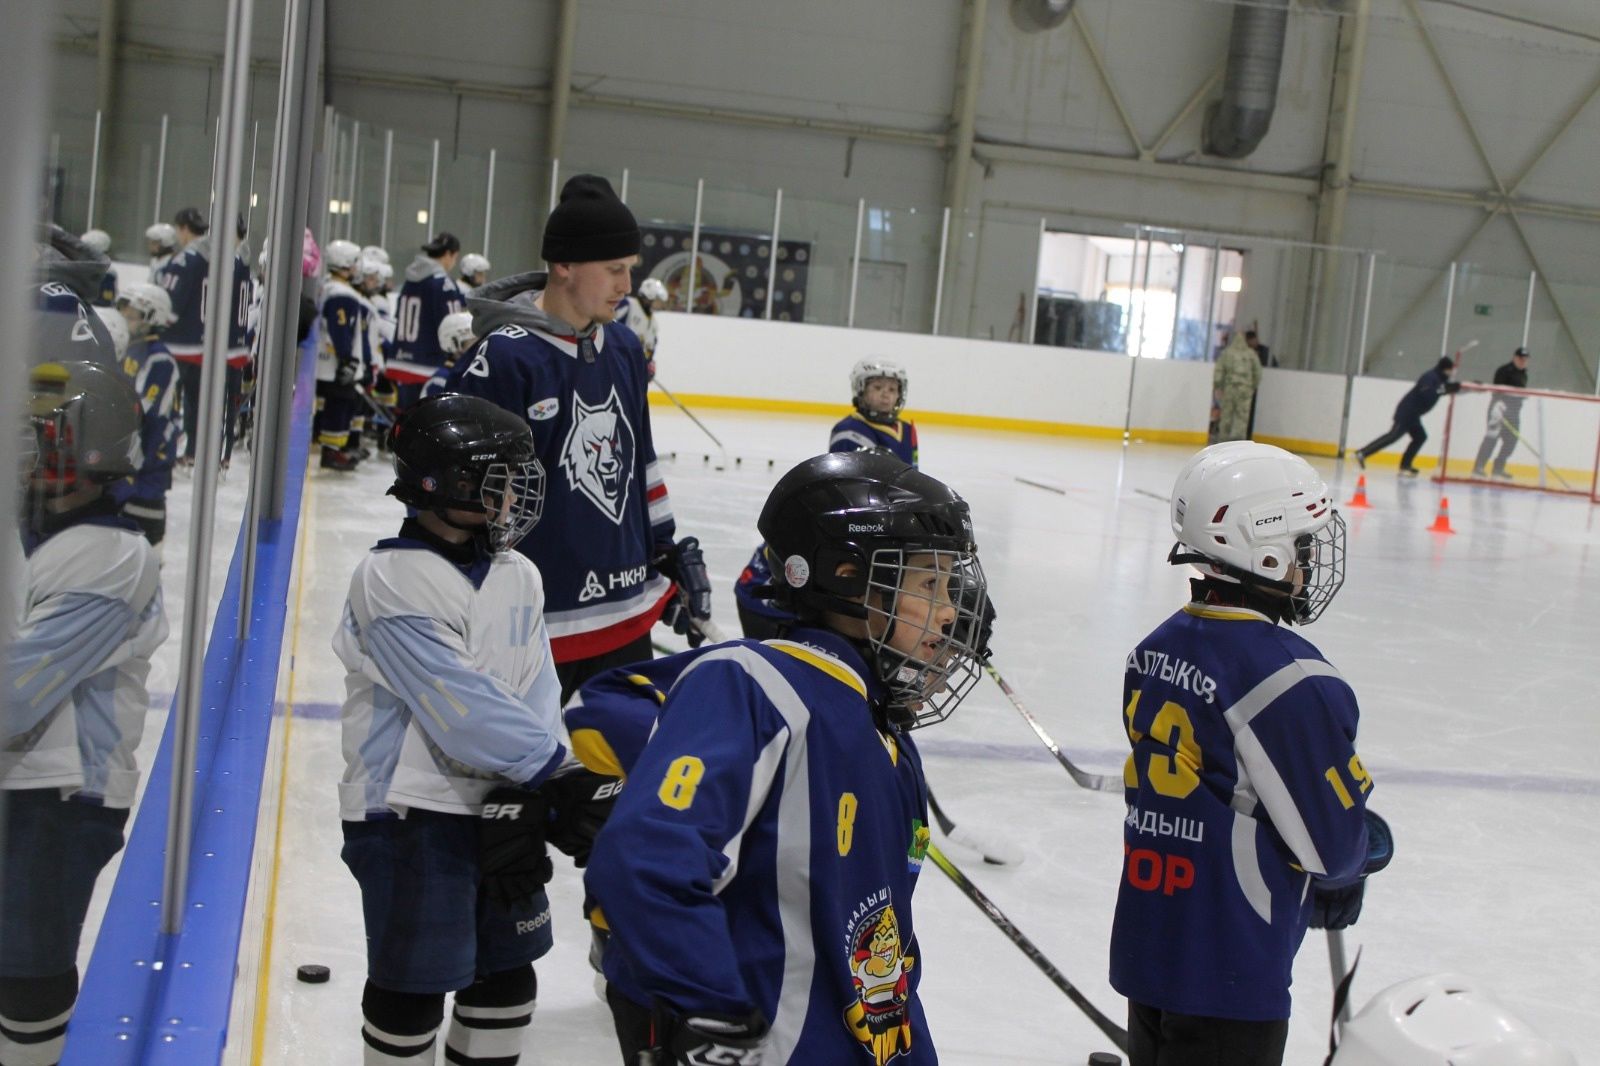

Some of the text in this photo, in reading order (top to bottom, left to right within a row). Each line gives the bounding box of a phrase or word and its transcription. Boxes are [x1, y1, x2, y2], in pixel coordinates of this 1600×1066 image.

[397, 295, 422, 343] 10
[471, 453, 497, 461] CCM
[848, 523, 884, 533] Reebok
[1255, 515, 1283, 526] CCM
[657, 754, 706, 812] 8
[1324, 753, 1373, 810] 19
[836, 791, 858, 857] 8
[1125, 844, 1196, 897] ОР
